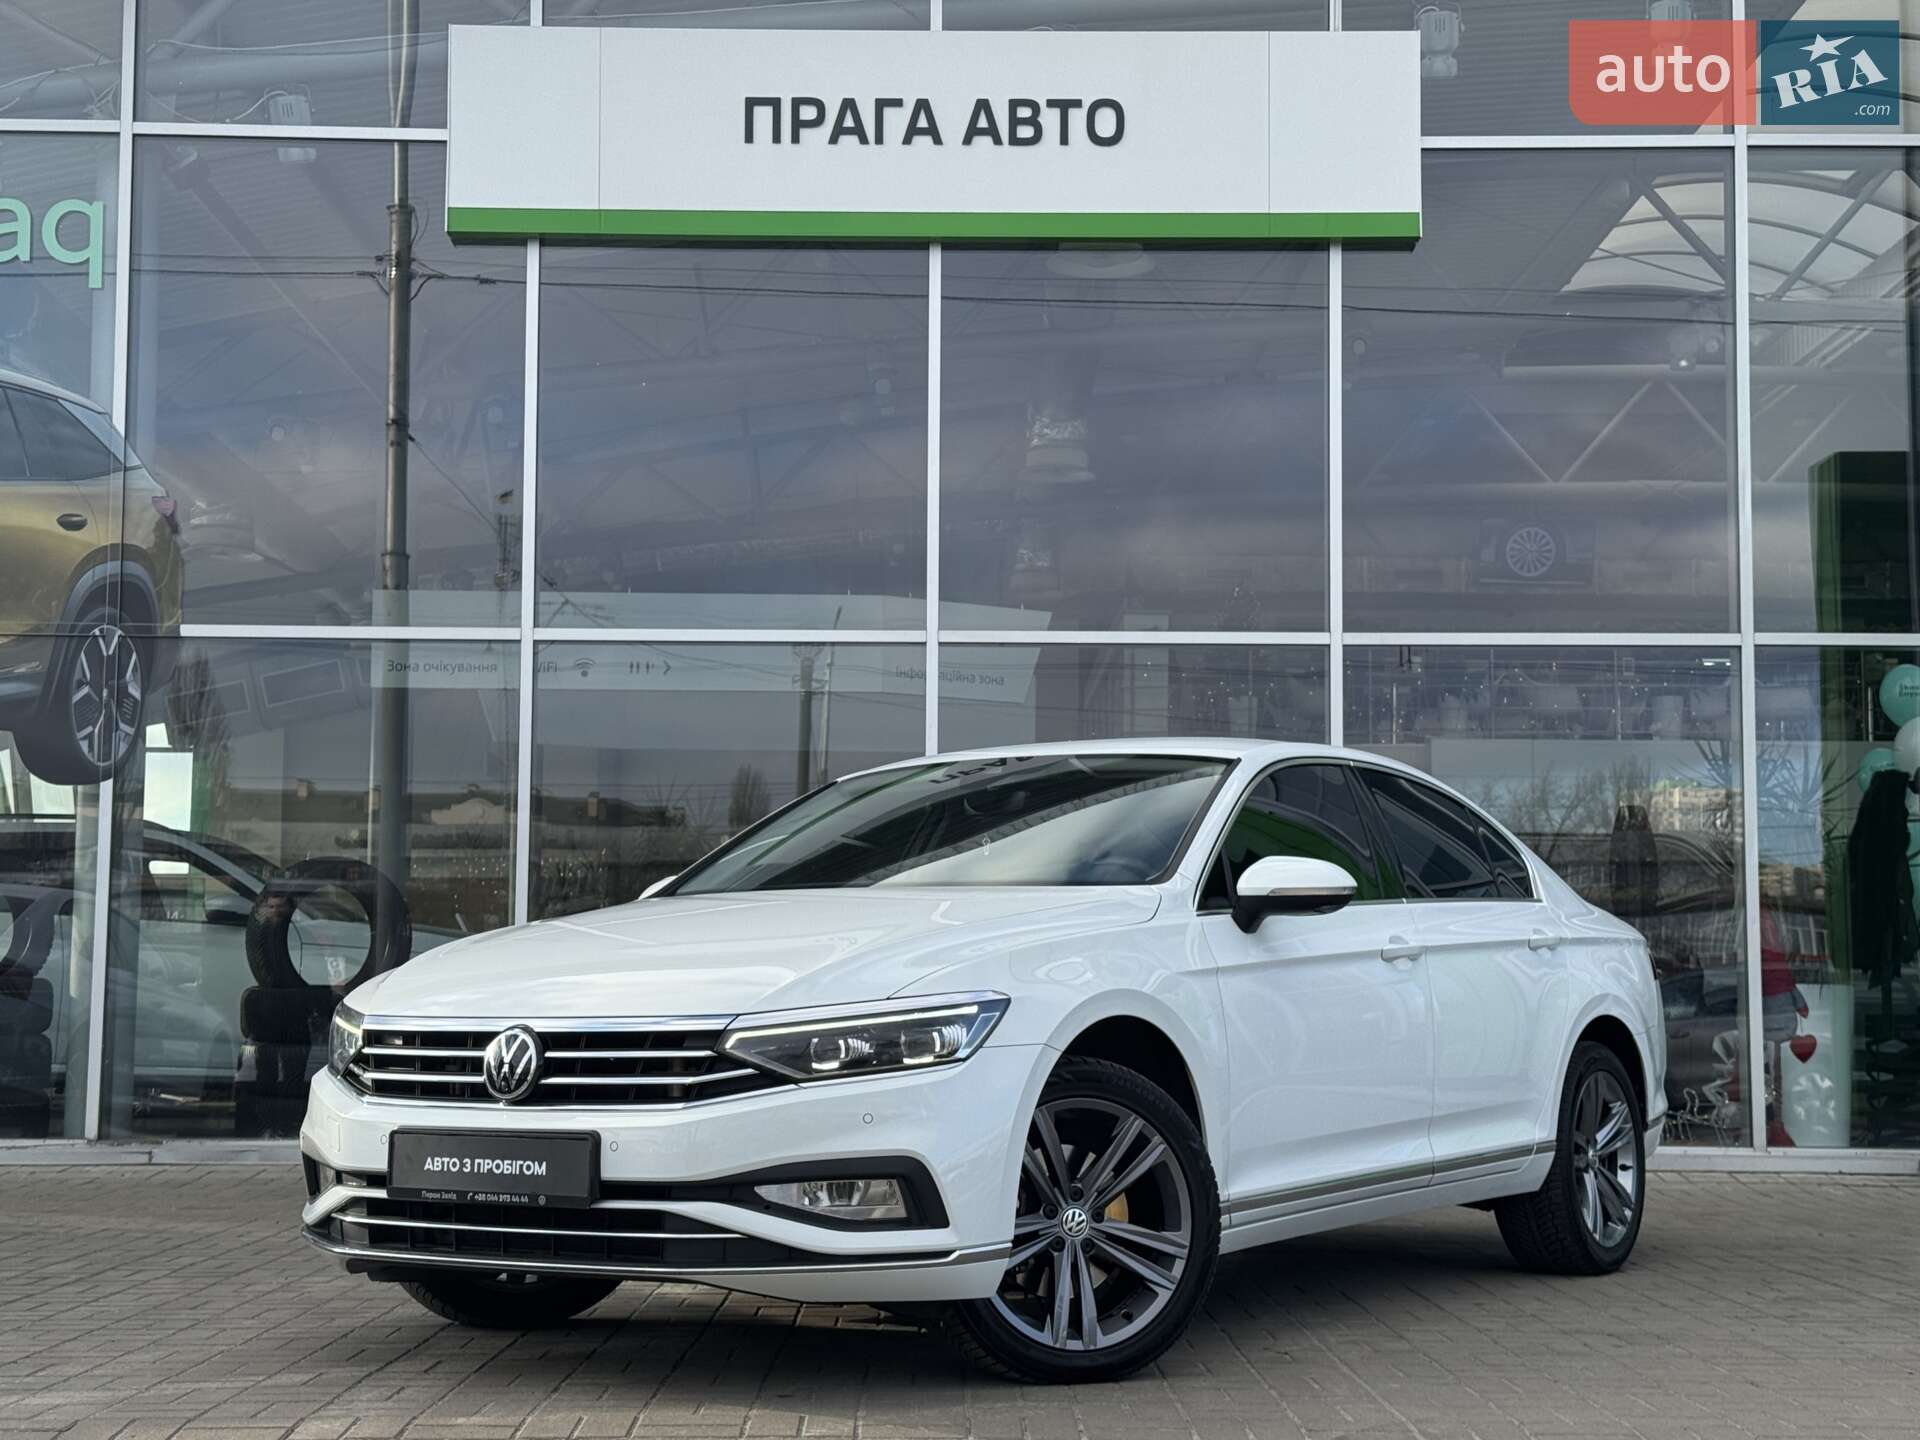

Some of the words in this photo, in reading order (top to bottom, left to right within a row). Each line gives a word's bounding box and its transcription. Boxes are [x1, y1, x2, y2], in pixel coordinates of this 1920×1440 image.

[744, 96, 944, 146] ПРАГА
[961, 98, 1126, 148] АВТО
[0, 198, 105, 289] aq
[386, 659, 420, 673] Зона
[423, 659, 498, 676] очікування
[979, 674, 1005, 687] зона
[424, 1156, 460, 1173] АВТО
[462, 1158, 472, 1174] З
[474, 1159, 547, 1177] ПРОБІГОМ
